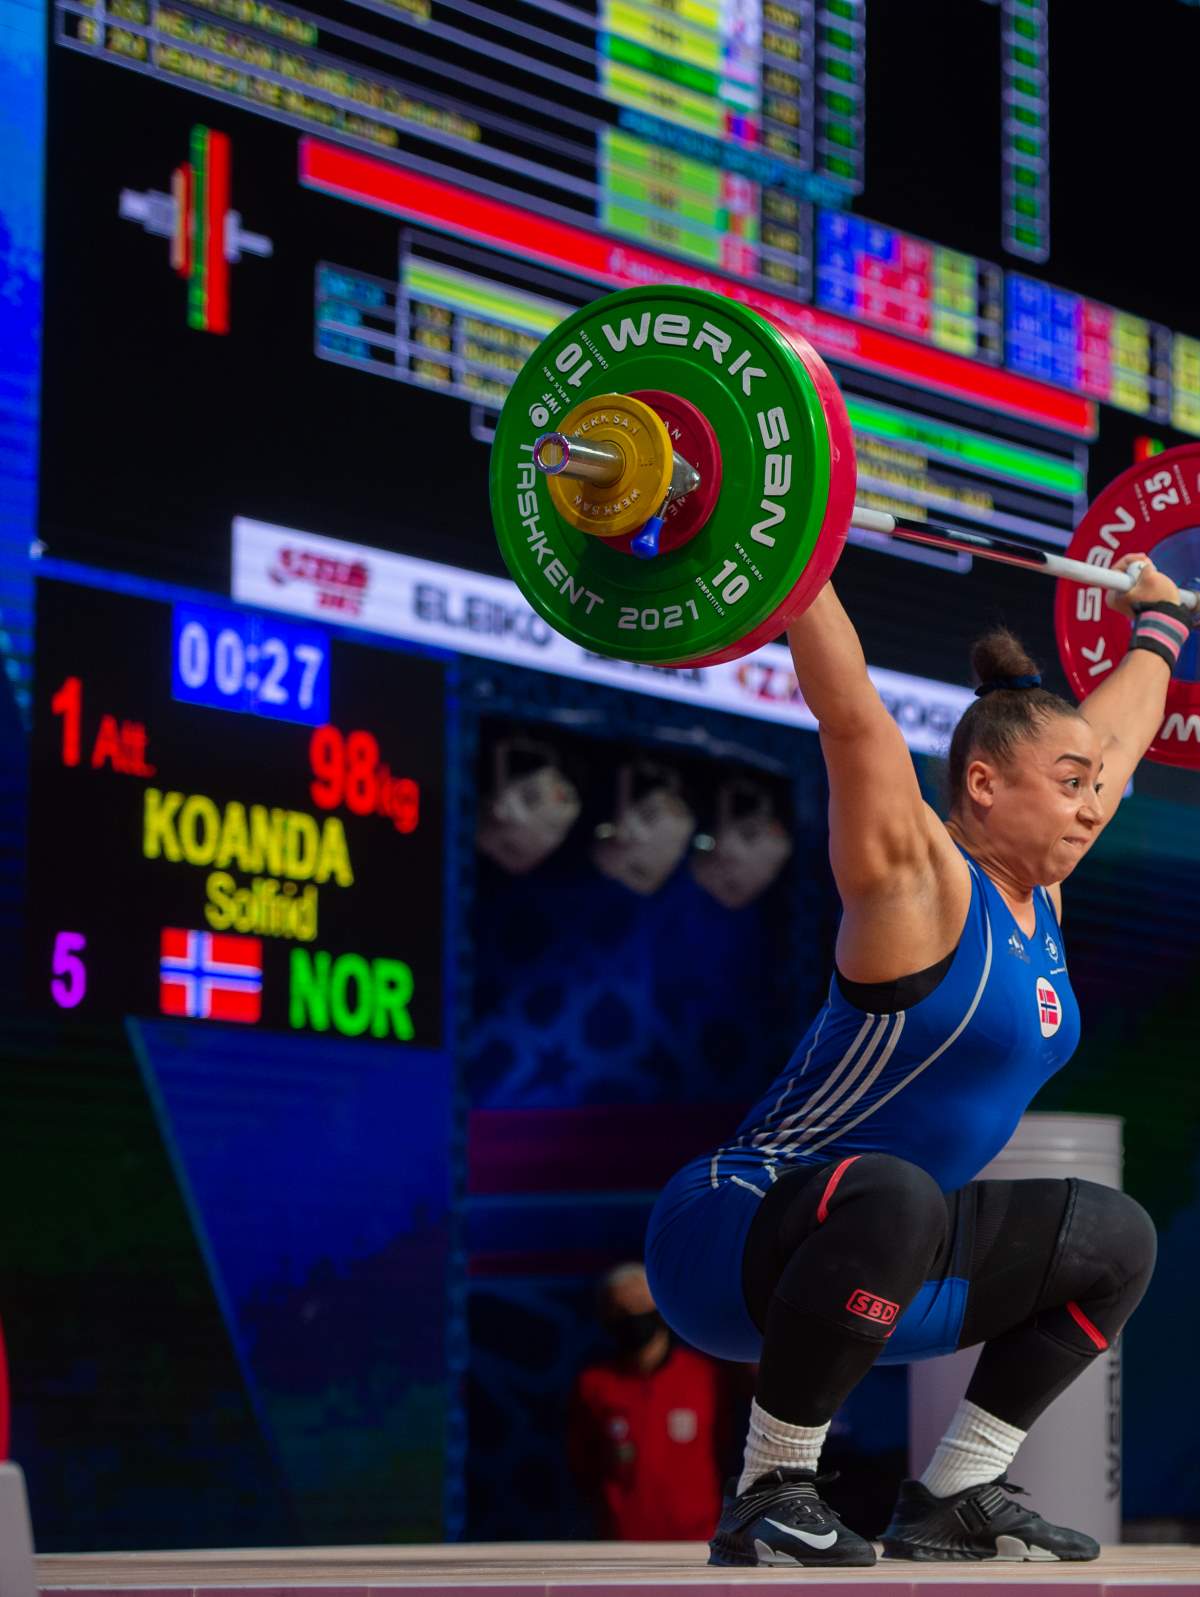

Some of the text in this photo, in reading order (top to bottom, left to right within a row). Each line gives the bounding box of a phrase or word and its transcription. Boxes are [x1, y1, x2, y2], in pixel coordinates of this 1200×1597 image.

[555, 342, 593, 388] 10
[541, 393, 562, 415] IWF
[1143, 470, 1180, 512] 25
[695, 576, 726, 617] COMPETITION
[711, 559, 751, 605] 10
[414, 583, 551, 648] ELEIKO
[617, 599, 700, 631] 2021
[178, 620, 325, 711] 00:27
[51, 676, 82, 767] 1
[142, 787, 355, 887] KOANDA
[50, 930, 86, 1009] 5
[288, 947, 415, 1041] NOR
[852, 1295, 896, 1322] SBD
